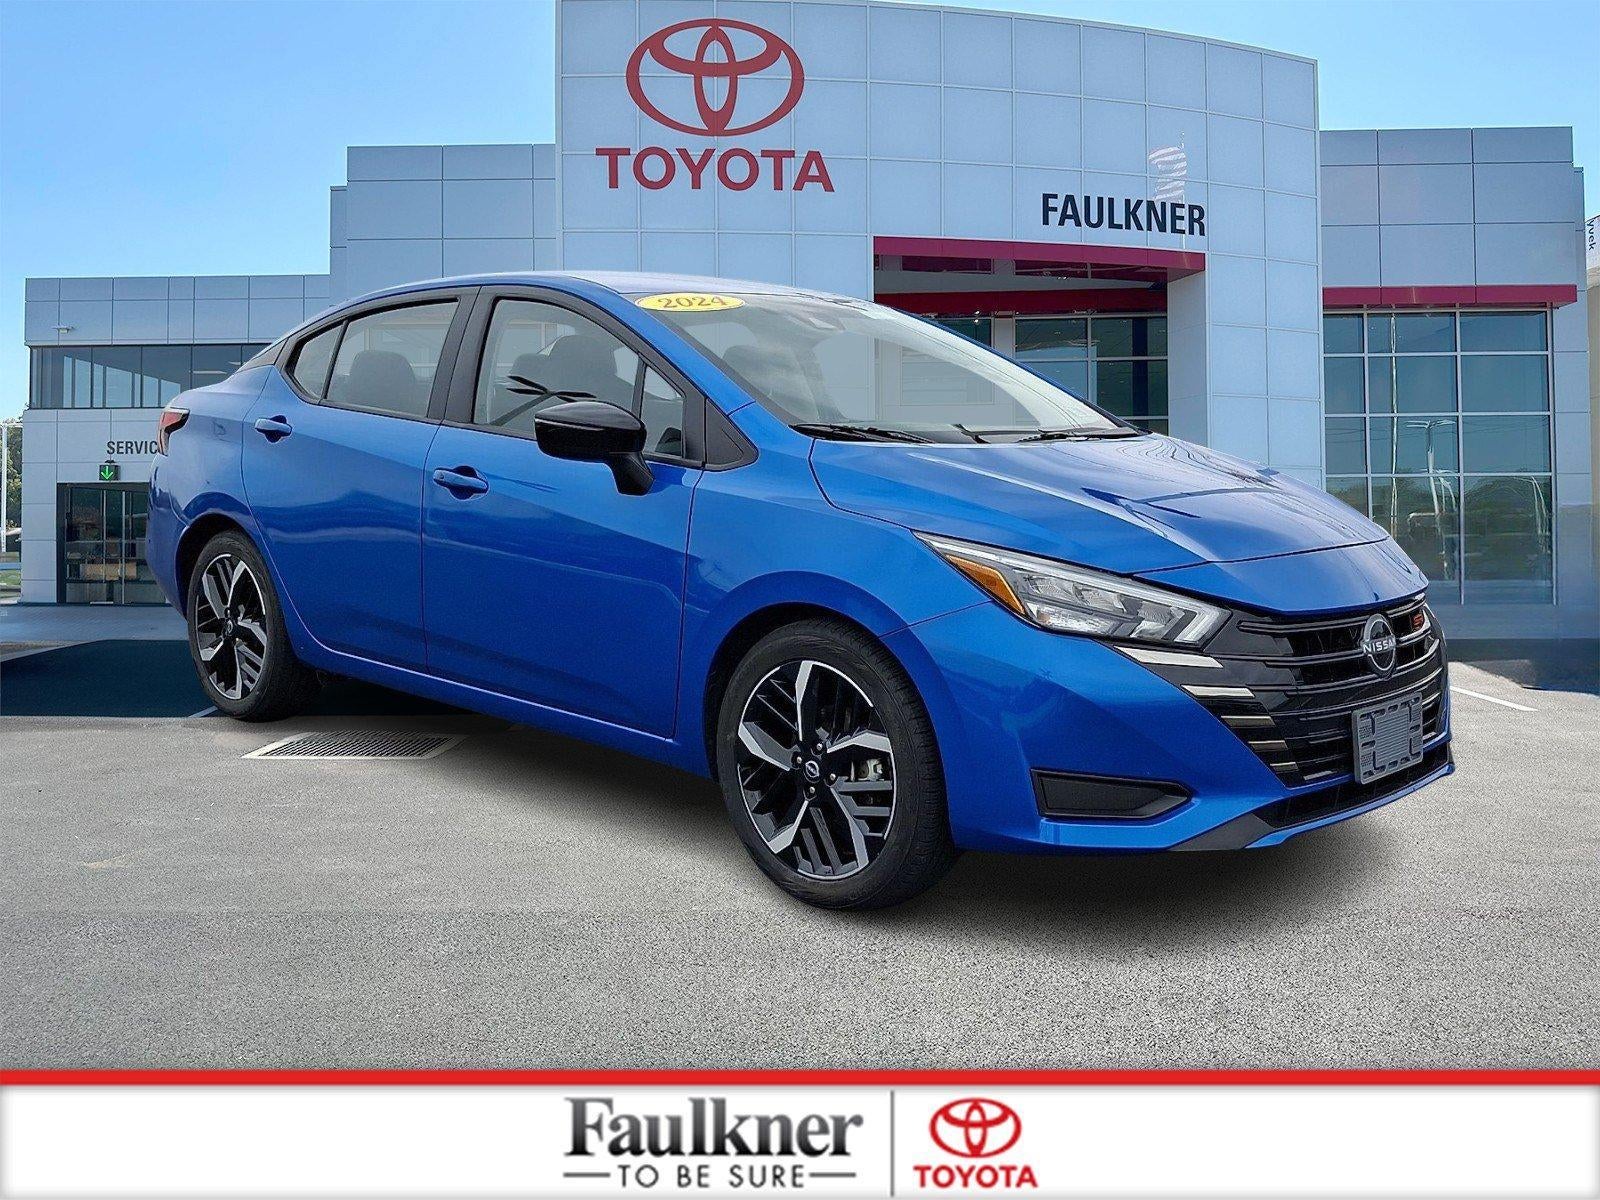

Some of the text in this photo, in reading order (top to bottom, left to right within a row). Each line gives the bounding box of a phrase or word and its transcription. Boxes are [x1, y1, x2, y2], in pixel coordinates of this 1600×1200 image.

[596, 148, 834, 191] TOYOTA
[1042, 193, 1206, 237] FAULKNER
[1587, 219, 1596, 250] yvek
[658, 296, 728, 309] 2024
[106, 440, 159, 455] SERVIC
[1363, 638, 1396, 654] NISSA
